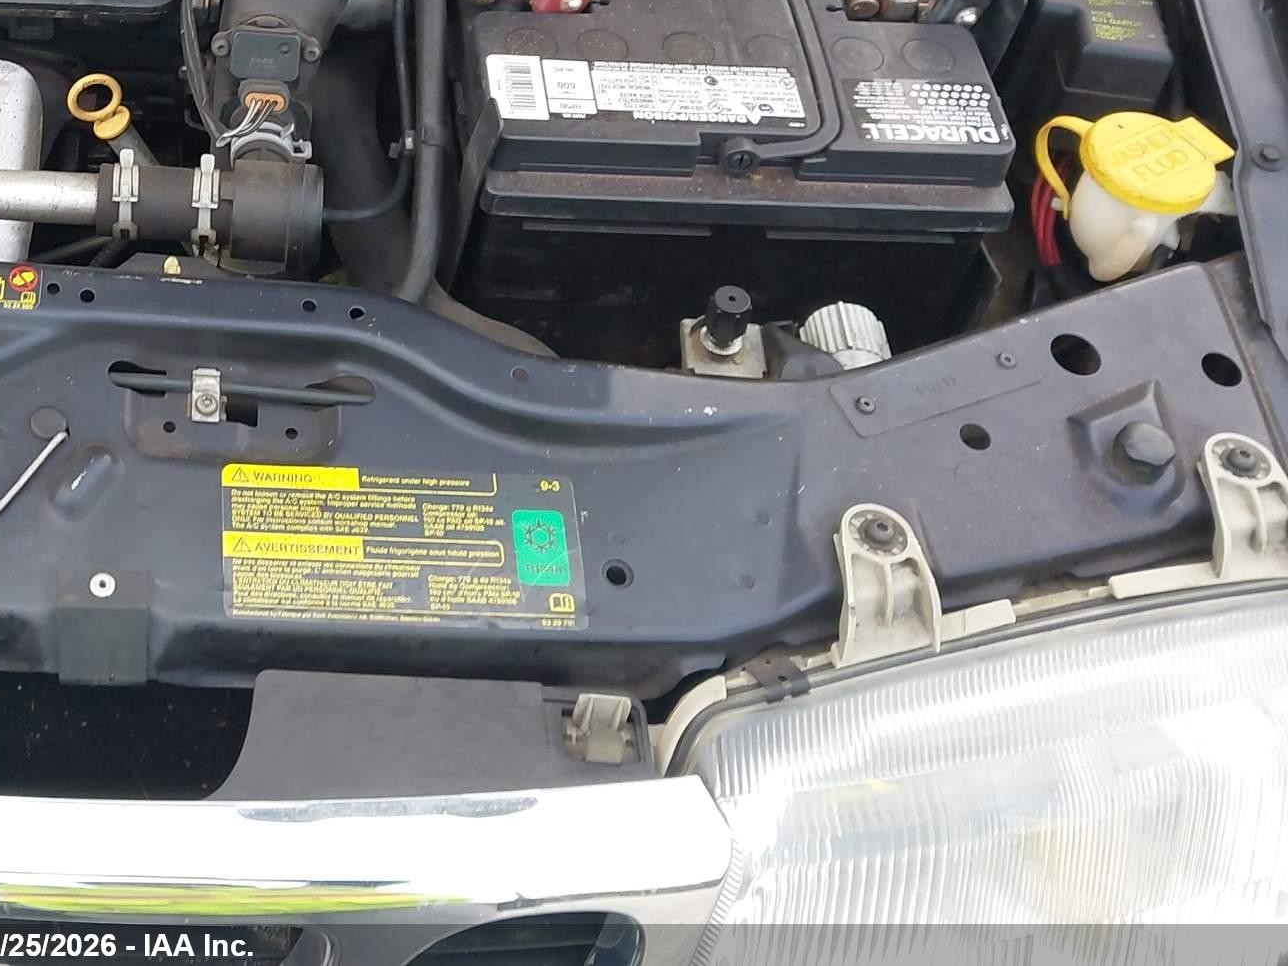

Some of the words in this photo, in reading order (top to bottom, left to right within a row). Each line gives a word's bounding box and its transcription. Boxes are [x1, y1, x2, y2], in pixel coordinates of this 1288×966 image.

[861, 122, 1000, 144] DURACELL
[253, 471, 313, 483] WARNING
[362, 475, 400, 484] Refrigerant
[401, 477, 422, 485] under
[423, 478, 439, 487] high
[439, 479, 470, 487] pressure
[540, 480, 560, 492] 9-3
[255, 541, 360, 556] AVERTISSEMENT
[366, 547, 388, 557] Fluide
[469, 550, 500, 560] pression
